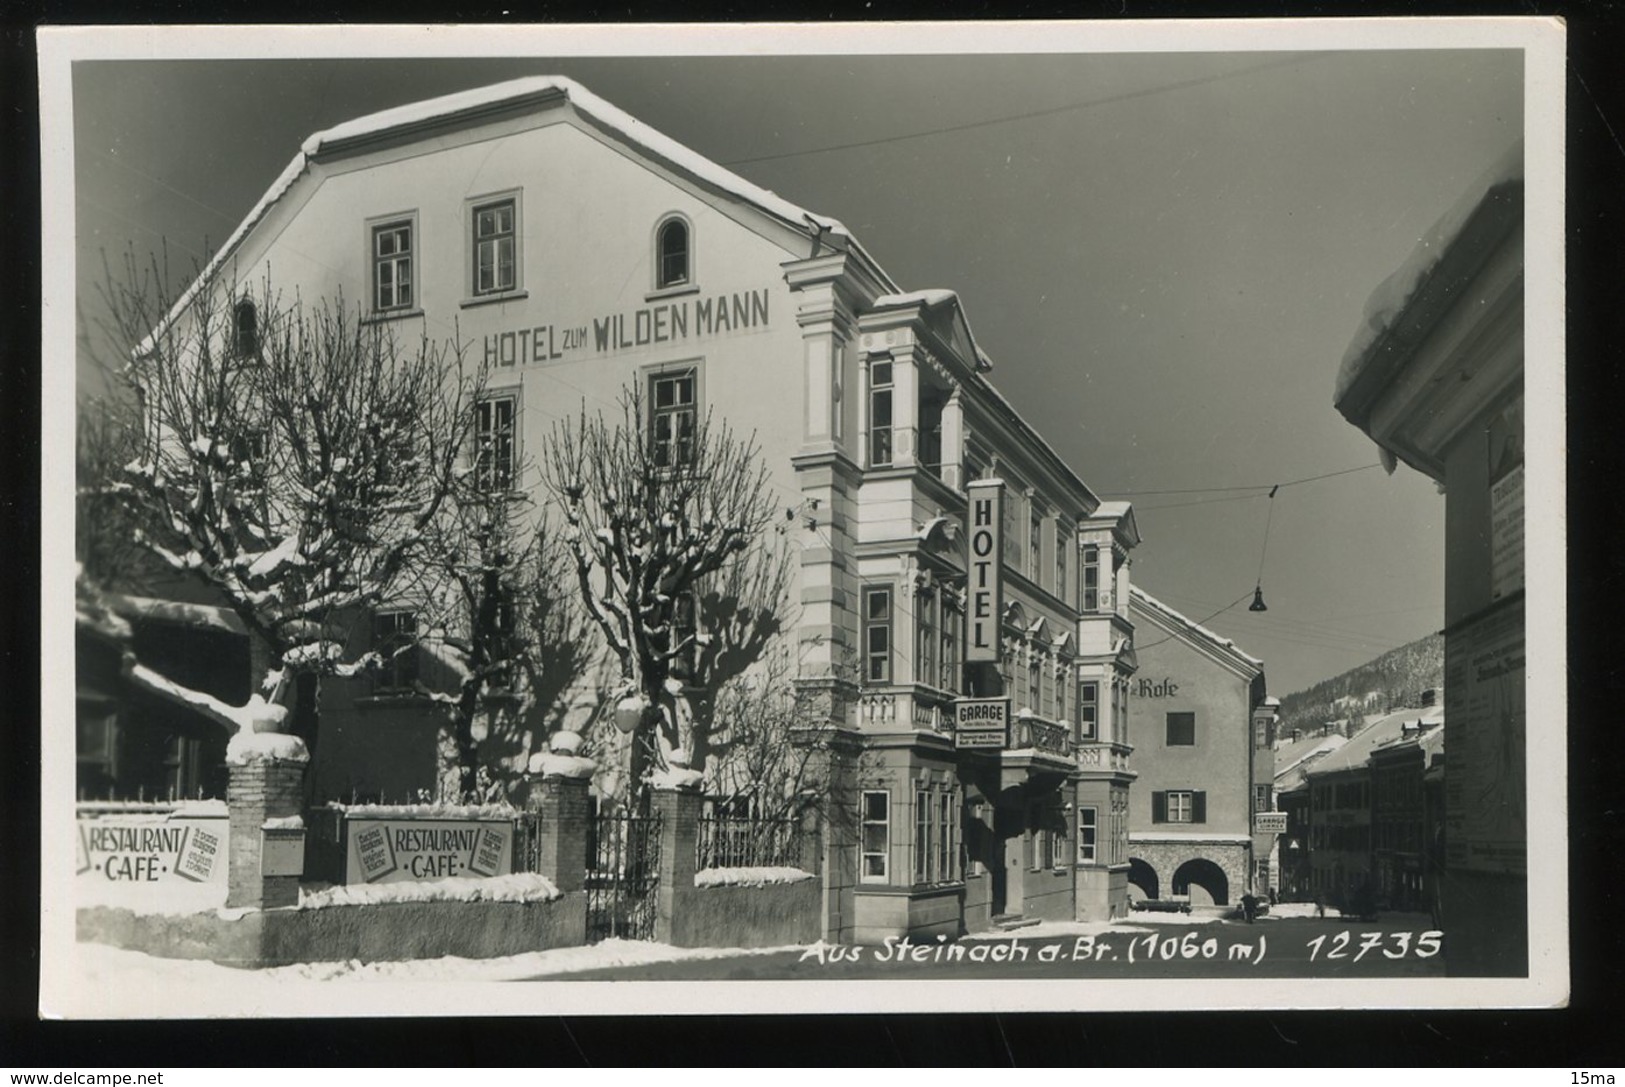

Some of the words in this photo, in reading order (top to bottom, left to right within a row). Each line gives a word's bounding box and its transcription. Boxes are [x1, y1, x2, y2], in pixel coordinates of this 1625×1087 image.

[484, 325, 562, 369] HOTEL
[562, 326, 588, 351] ZUM
[593, 302, 688, 352] WILDEN
[696, 288, 769, 337] MANN
[973, 500, 993, 649] HOTEL
[960, 705, 1003, 722] GARAGE
[90, 827, 182, 853] RESTAURANT
[396, 829, 475, 853] RESTAURANT
[105, 853, 160, 882] CAFÉ
[411, 852, 459, 879] CAFÉ
